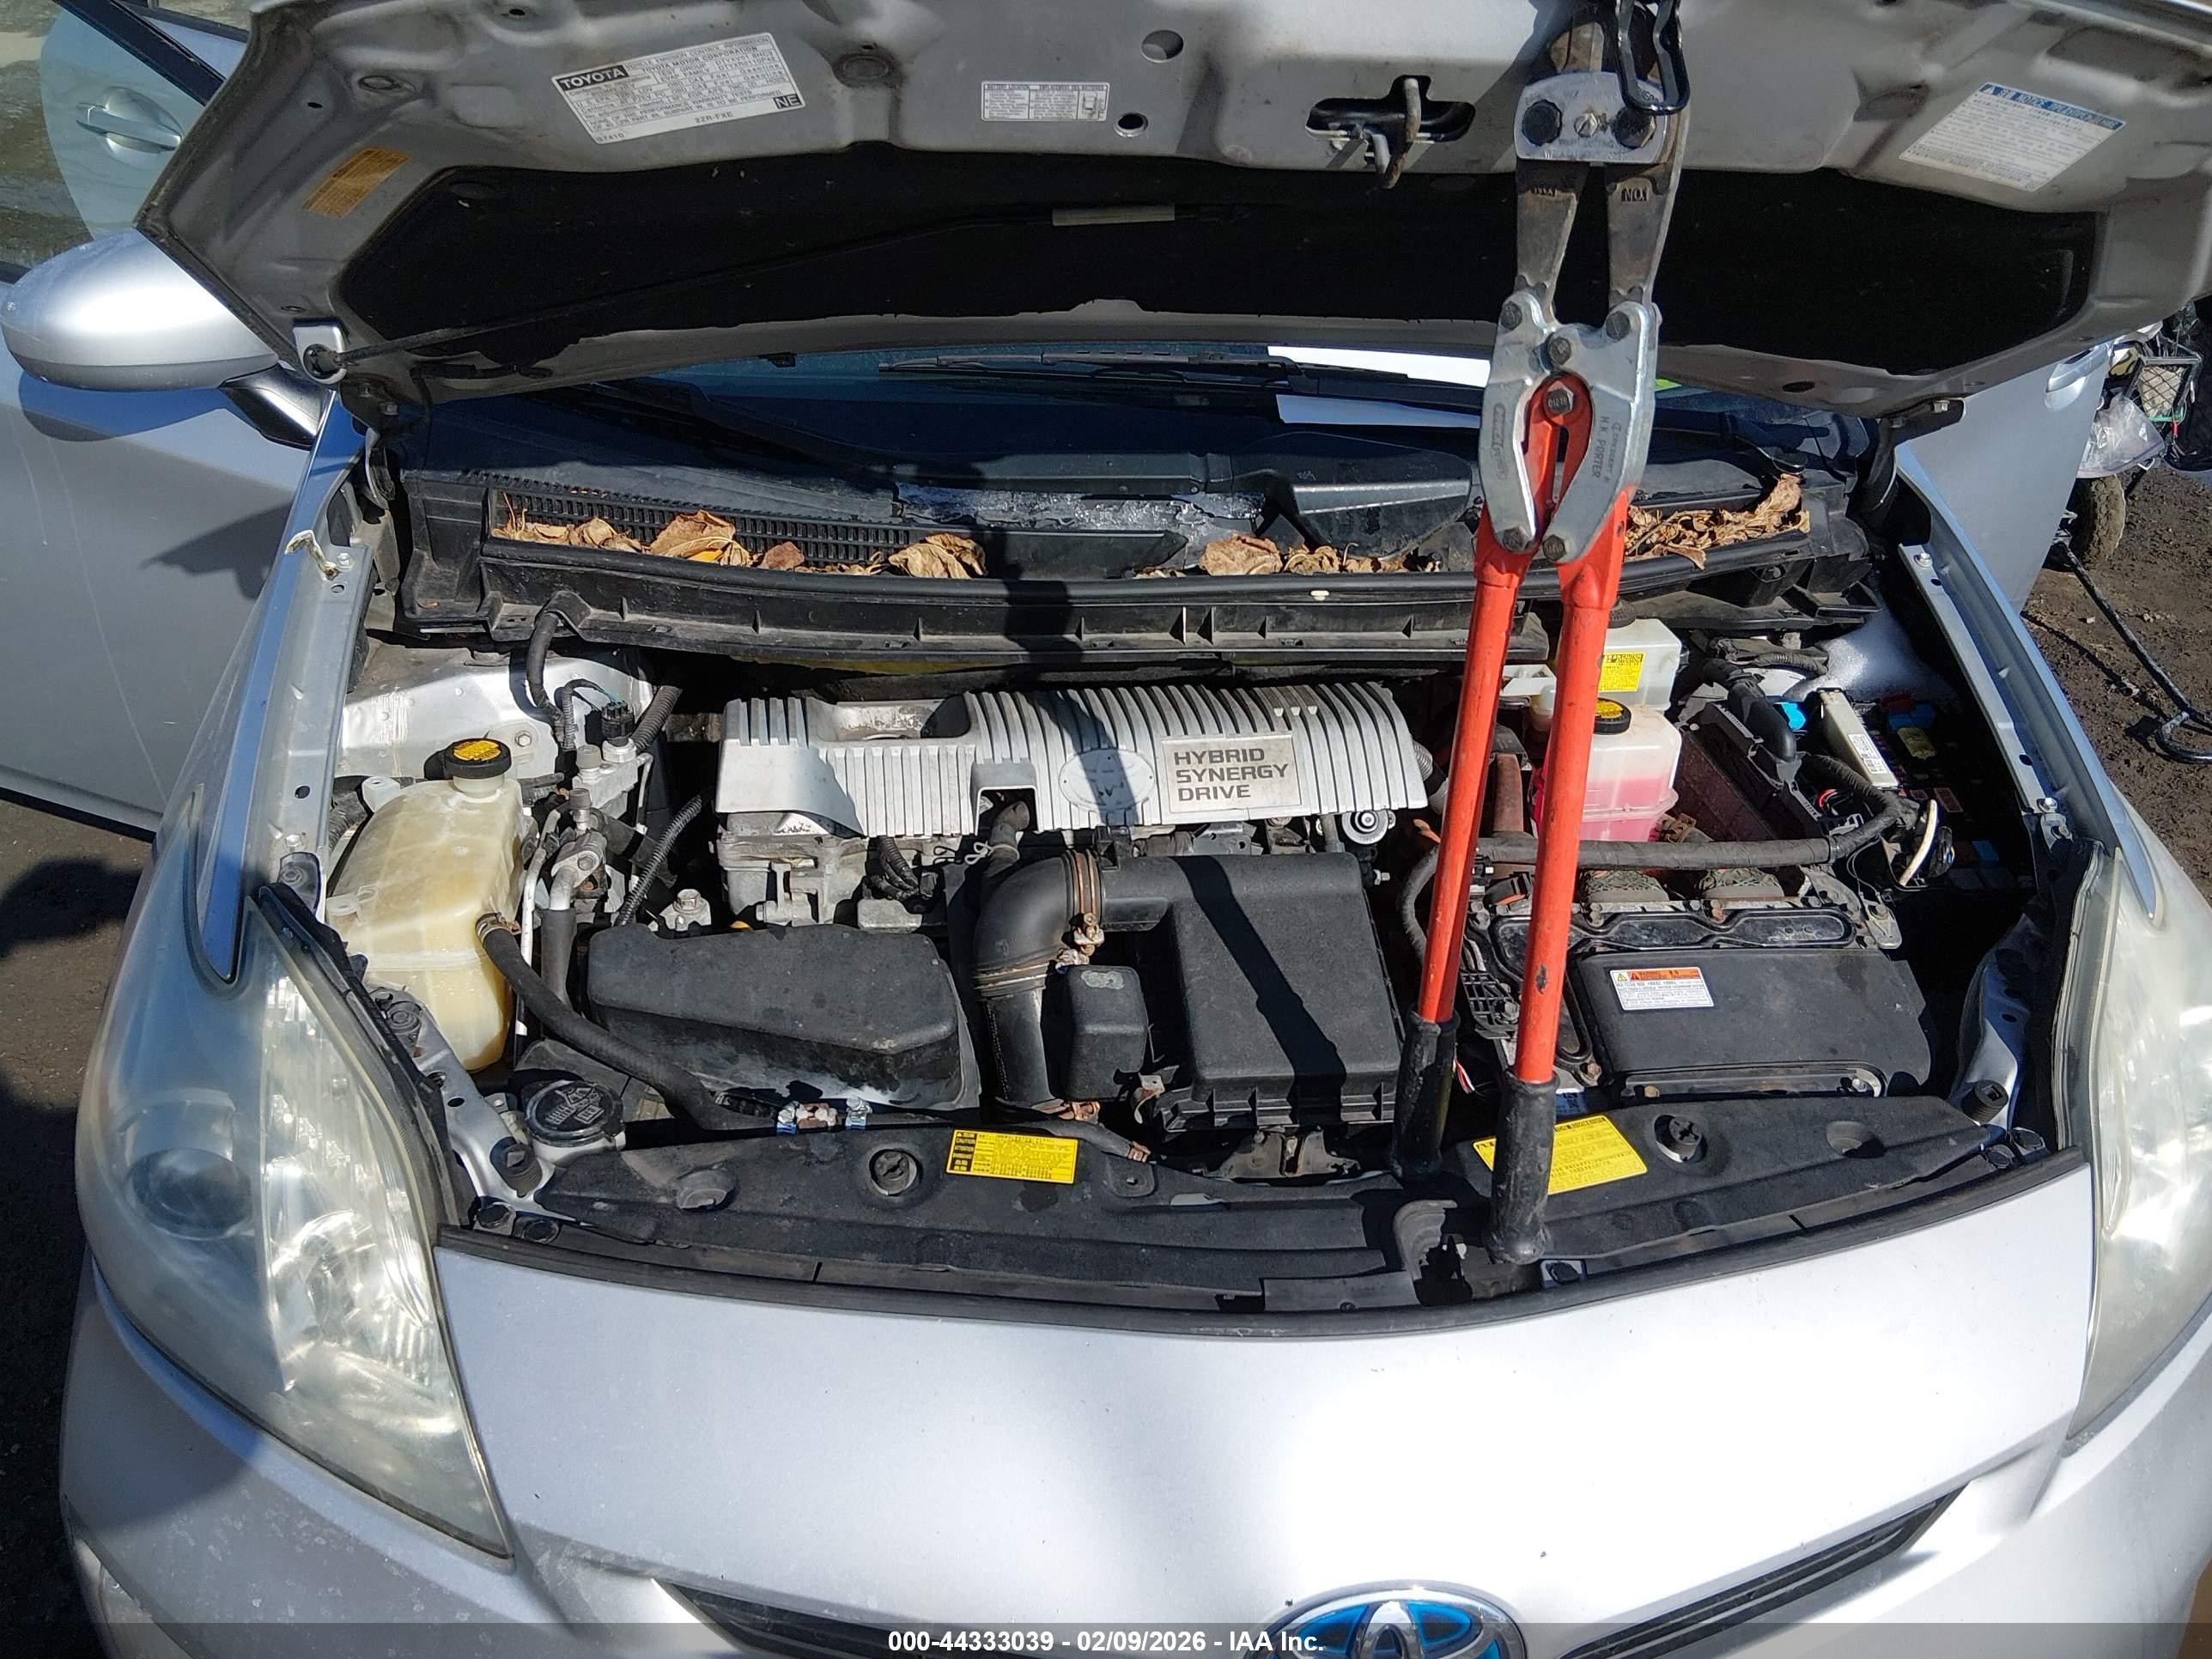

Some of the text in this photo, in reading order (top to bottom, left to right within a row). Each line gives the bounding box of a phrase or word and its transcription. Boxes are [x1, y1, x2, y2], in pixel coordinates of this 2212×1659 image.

[641, 45, 757, 73] TOYOTA MOTOR CORPORATION
[560, 68, 625, 88] TOYOTA
[776, 95, 801, 108] NE
[1593, 441, 1606, 477] PORTER
[1174, 749, 1265, 765] HYBRID
[1176, 763, 1289, 784] SYNERGY
[1178, 784, 1251, 802] DRIVE
